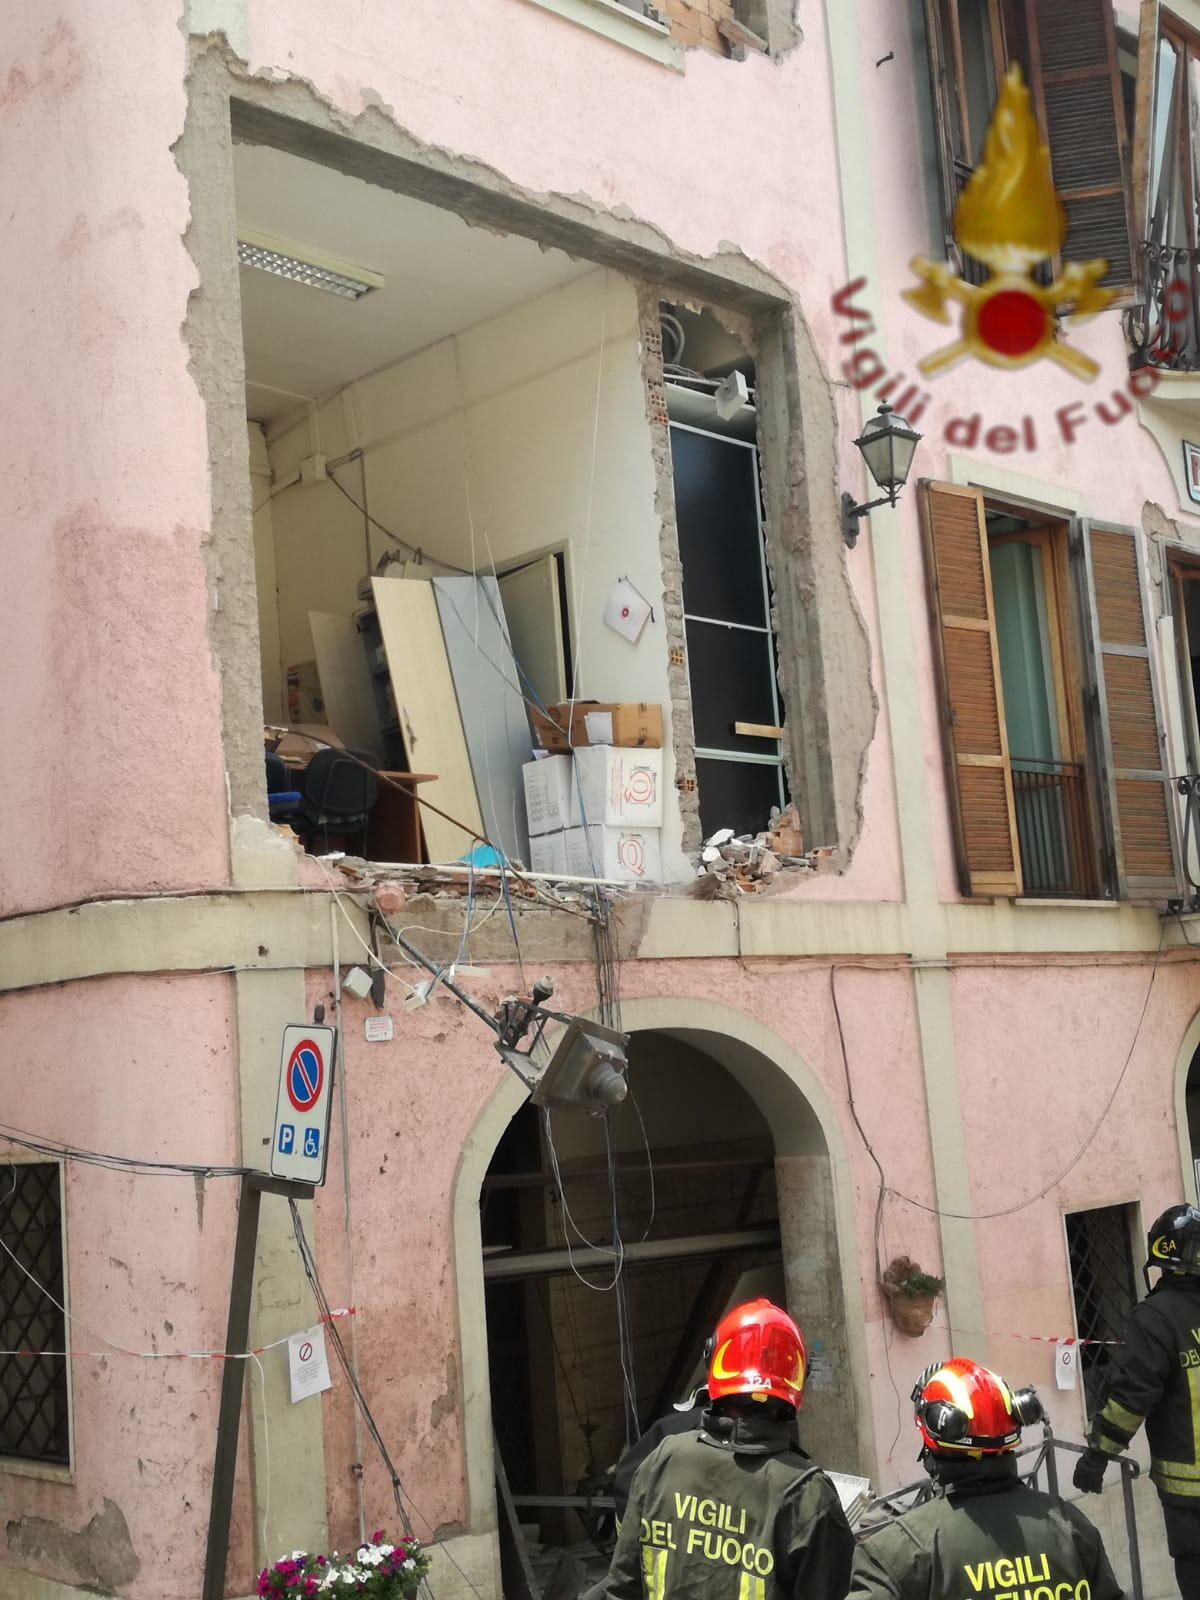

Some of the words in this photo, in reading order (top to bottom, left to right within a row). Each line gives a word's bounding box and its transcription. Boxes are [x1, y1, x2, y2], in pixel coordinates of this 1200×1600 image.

[282, 1127, 293, 1151] P
[1161, 1239, 1177, 1253] 3A
[674, 1491, 747, 1535] VIGILI
[639, 1517, 677, 1550] DEL
[686, 1528, 775, 1576] FUOCO
[964, 1553, 1051, 1592] VIGILI
[994, 1579, 1092, 1600] OCO
